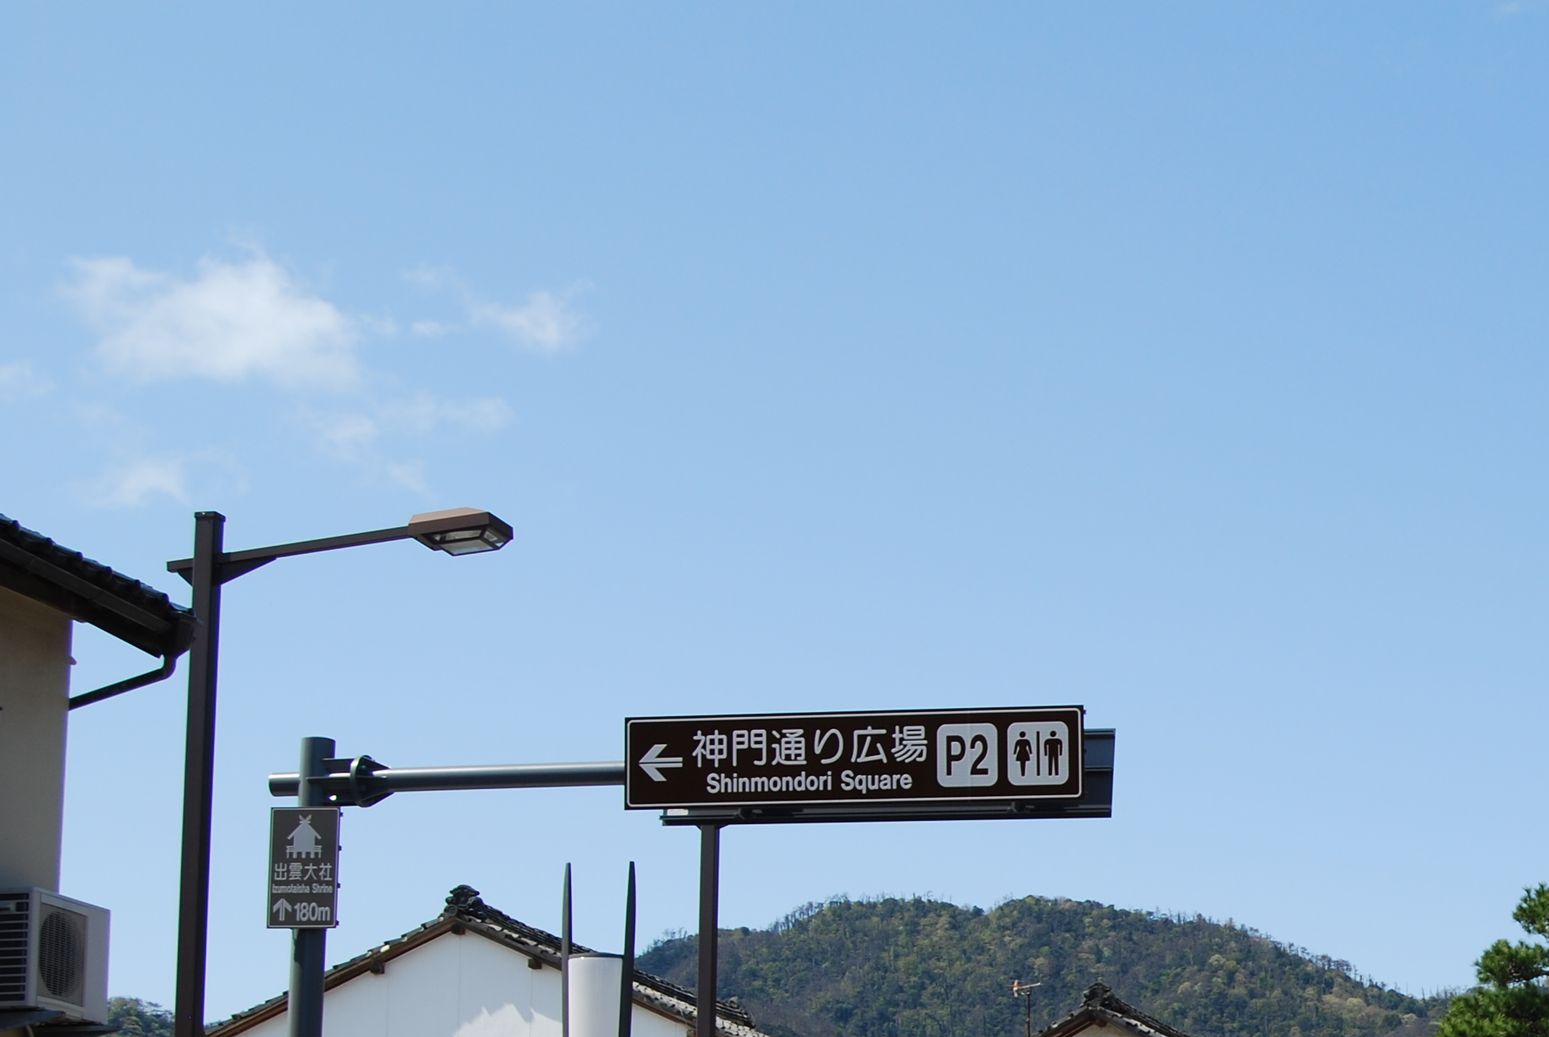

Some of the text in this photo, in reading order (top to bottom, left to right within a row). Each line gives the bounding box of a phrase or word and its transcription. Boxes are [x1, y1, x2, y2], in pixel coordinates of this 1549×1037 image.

[691, 725, 928, 769] 神門通り広場
[945, 734, 990, 777] P2
[705, 769, 913, 795] Shinmondori Square
[273, 862, 333, 881] 出雲大社
[294, 902, 331, 921] 180m
